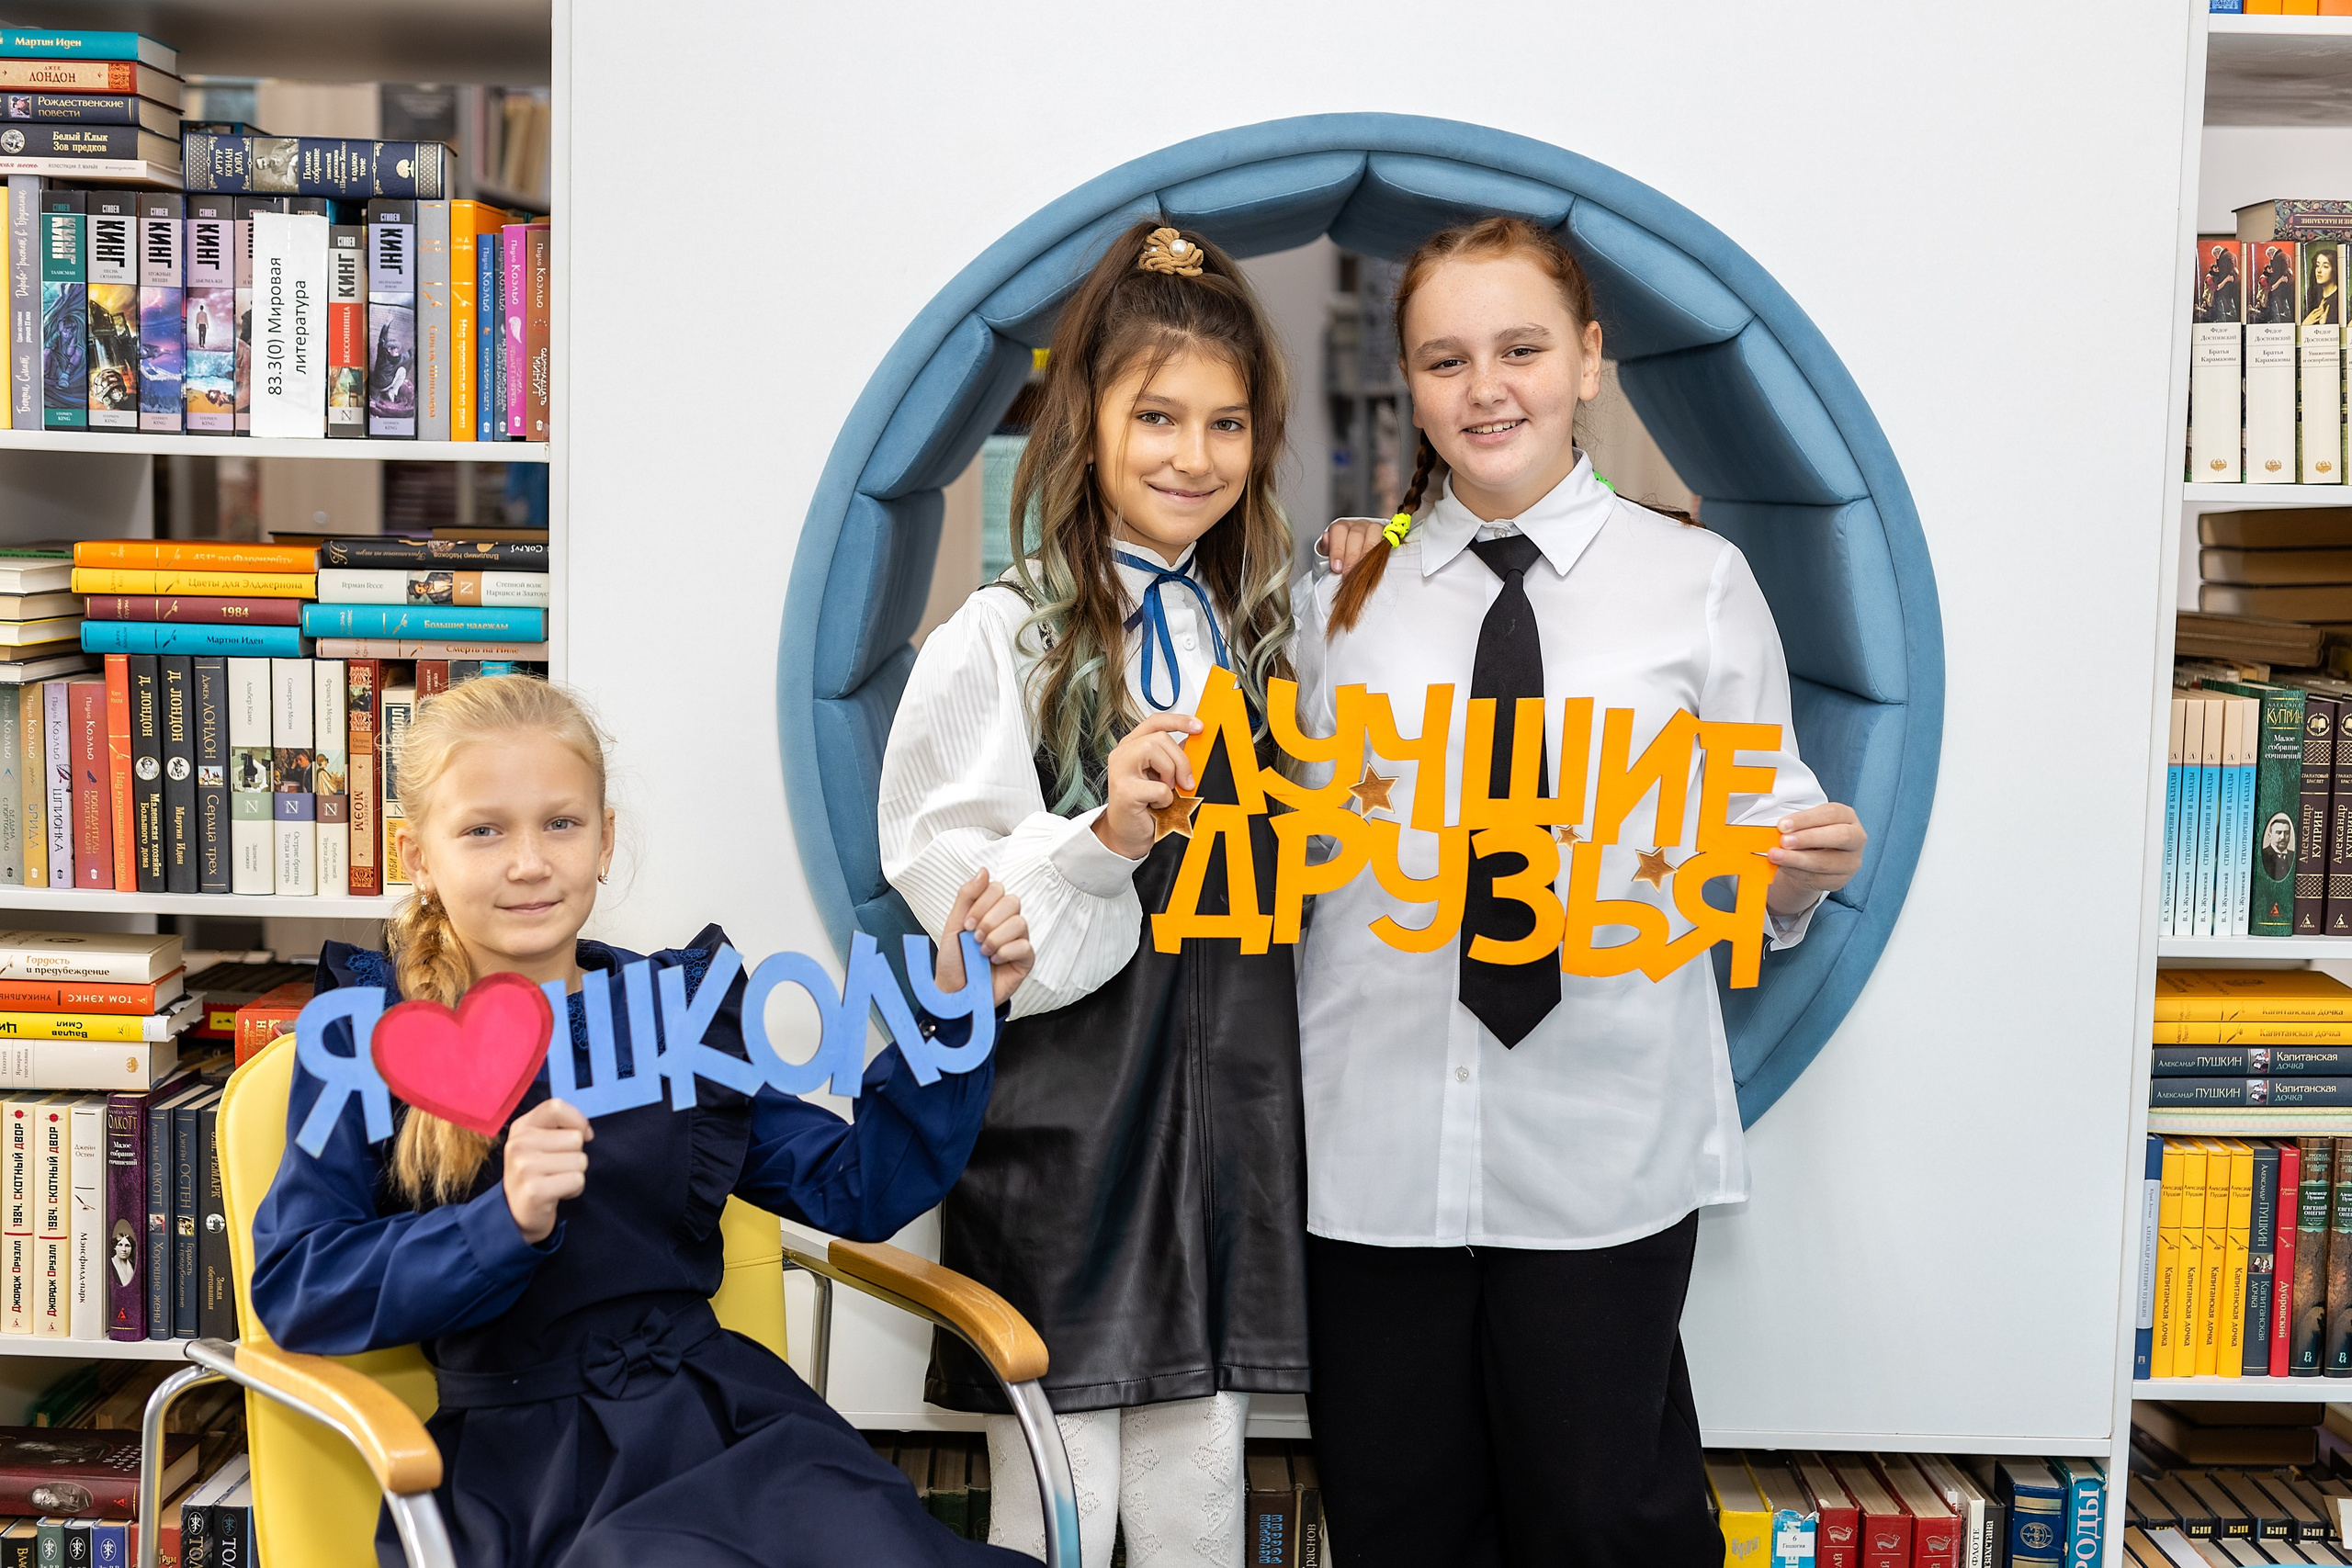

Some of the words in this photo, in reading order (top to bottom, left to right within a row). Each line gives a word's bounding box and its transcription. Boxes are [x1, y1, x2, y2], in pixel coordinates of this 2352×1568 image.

[15, 37, 53, 48] Мартин
[56, 38, 82, 47] Иден
[29, 70, 76, 83] ЛОНДОН
[38, 96, 124, 109] Рождественские
[39, 108, 81, 118] повести
[52, 130, 81, 141] Белый
[84, 132, 108, 142] Клык
[53, 141, 70, 152] Зов
[73, 142, 107, 153] предков
[215, 149, 223, 175] АРТУР
[233, 152, 243, 175] ДОЙЛ
[303, 150, 311, 180] Полное
[313, 148, 322, 184] собрание
[102, 204, 120, 214] СТИВЕН
[51, 217, 76, 265] КИНГ
[96, 220, 126, 268] КИНГ
[148, 221, 172, 269] КИНГ
[197, 223, 220, 271] КИНГ
[379, 228, 403, 275] КИНГ
[510, 239, 518, 264] Пауло
[536, 243, 544, 266] Пауло
[337, 253, 356, 299] КИНГ
[481, 247, 491, 271] Пауло
[267, 257, 286, 333] Мировая
[481, 272, 492, 311] Коэльо
[510, 265, 521, 305] Коэльо
[536, 267, 546, 309] Коэльо
[294, 279, 310, 375] литература
[343, 306, 352, 364] БЕССОННИЦА
[458, 319, 468, 338] Над
[16, 355, 30, 381] Смит
[267, 338, 286, 396] 83.3(0)
[532, 355, 542, 395] МИНУТ
[16, 384, 30, 413] Бетти
[433, 551, 462, 559] Набоков
[463, 552, 500, 560] Владимир
[188, 579, 220, 589] Цветы
[222, 580, 240, 589] для
[242, 579, 303, 591] Элджернона
[494, 581, 525, 589] Степной
[221, 606, 250, 618] 1984
[424, 620, 464, 630] Большие
[467, 621, 509, 631] надежды
[206, 635, 240, 645] Мартин
[242, 636, 264, 646] Иден
[446, 644, 481, 654] Смерть
[496, 645, 519, 654] Ниле
[138, 675, 151, 687] Д.
[167, 670, 182, 683] Д.
[324, 678, 334, 706] Франсуа
[27, 695, 35, 717] Пауло
[286, 678, 294, 713] Сомерсет
[140, 690, 153, 737] ЛОНДОН
[168, 687, 184, 742] ЛОНДОН
[202, 702, 217, 759] ЛОНДОН
[325, 707, 334, 735] Мориак
[4, 719, 15, 759] Коэльо
[28, 719, 38, 759] Коэльо
[52, 720, 62, 761] Коэльо
[85, 720, 96, 761] Коэльо
[2267, 743, 2300, 752] собрание
[2274, 734, 2296, 742] Малое
[1191, 663, 1784, 854] ЛУЧШИЕ
[28, 803, 39, 850] БРИДА
[52, 787, 63, 852] ШПИОНКА
[90, 789, 99, 854] ПОБЕДИТЕЛЬ
[139, 802, 150, 844] Большого
[149, 793, 161, 840] Маленькая
[175, 806, 186, 840] Мартин
[204, 794, 220, 841] Сердца
[354, 790, 364, 832] МОЭМ
[284, 832, 292, 852] Тогда
[292, 831, 301, 858] Острие
[388, 821, 397, 838] ИЛИ
[2184, 811, 2193, 865] СТИХОТВОРЕНИЯ
[2202, 812, 2211, 866] СТИХОТВОРЕНИЯ
[2223, 813, 2233, 866] СТИХОТВОРЕНИЯ
[2241, 811, 2249, 865] СТИХОТВОРЕНИЯ
[2299, 804, 2313, 864] Александр
[2312, 810, 2324, 859] КУПРИН
[2333, 804, 2348, 864] Александр
[141, 846, 150, 868] дома
[151, 842, 162, 877] хозяйка
[175, 842, 187, 864] Иден
[206, 846, 219, 874] трех
[388, 840, 398, 858] ДИК
[389, 858, 398, 881] МОБИ
[1150, 803, 1780, 990] ДРУЗЬЯ
[2200, 872, 2209, 907] Жуковский
[27, 955, 70, 966] Гордость
[34, 966, 110, 977] предубеждение
[68, 994, 105, 1004] ХЭНКС
[110, 995, 132, 1004] ТОМ
[51, 1030, 88, 1039] Вацлав
[295, 986, 393, 1160] Я
[540, 929, 996, 1120] ШКОЛУ
[2259, 1029, 2313, 1038] Капитанская
[2315, 1031, 2341, 1039] дочка
[2197, 1056, 2242, 1067] ПУШКИН
[2276, 1062, 2304, 1070] дочка
[2277, 1052, 2338, 1063] Капитанская
[2195, 1088, 2241, 1099] ПУШКИН
[2275, 1083, 2336, 1094] Капитанская
[2275, 1094, 2303, 1102] дочка
[152, 1162, 163, 1207] ОЛКОТТ
[179, 1163, 191, 1208] ОСТЕН
[210, 1155, 220, 1198] РЕМАРК
[2257, 1201, 2269, 1247] ПУШКИН
[78, 1232, 88, 1303] Мэнсфилд-парк
[152, 1242, 164, 1291] Хорошие
[186, 1242, 195, 1276] Гордость
[207, 1265, 216, 1310] обетованная
[215, 1277, 224, 1301] Земля
[2162, 1267, 2173, 1319] Капитанская
[2185, 1267, 2196, 1319] Капитанская
[2208, 1267, 2219, 1318] Капитанская
[2232, 1267, 2243, 1320] Капитанская
[2250, 1280, 2258, 1308] дочка
[153, 1294, 162, 1324] жены
[2258, 1280, 2270, 1341] Капитанская
[2278, 1280, 2290, 1338] Дубровский
[2160, 1320, 2169, 1347] дочка
[2183, 1320, 2192, 1347] дочка
[2206, 1319, 2214, 1346] дочка
[2230, 1321, 2239, 1348] дочка
[1259, 1514, 1272, 1564] ИСТОРИЯ
[1271, 1514, 1283, 1564] РОССИИ
[1302, 1523, 1317, 1568] раснов
[1972, 1528, 1980, 1567] ФЛОТЕ
